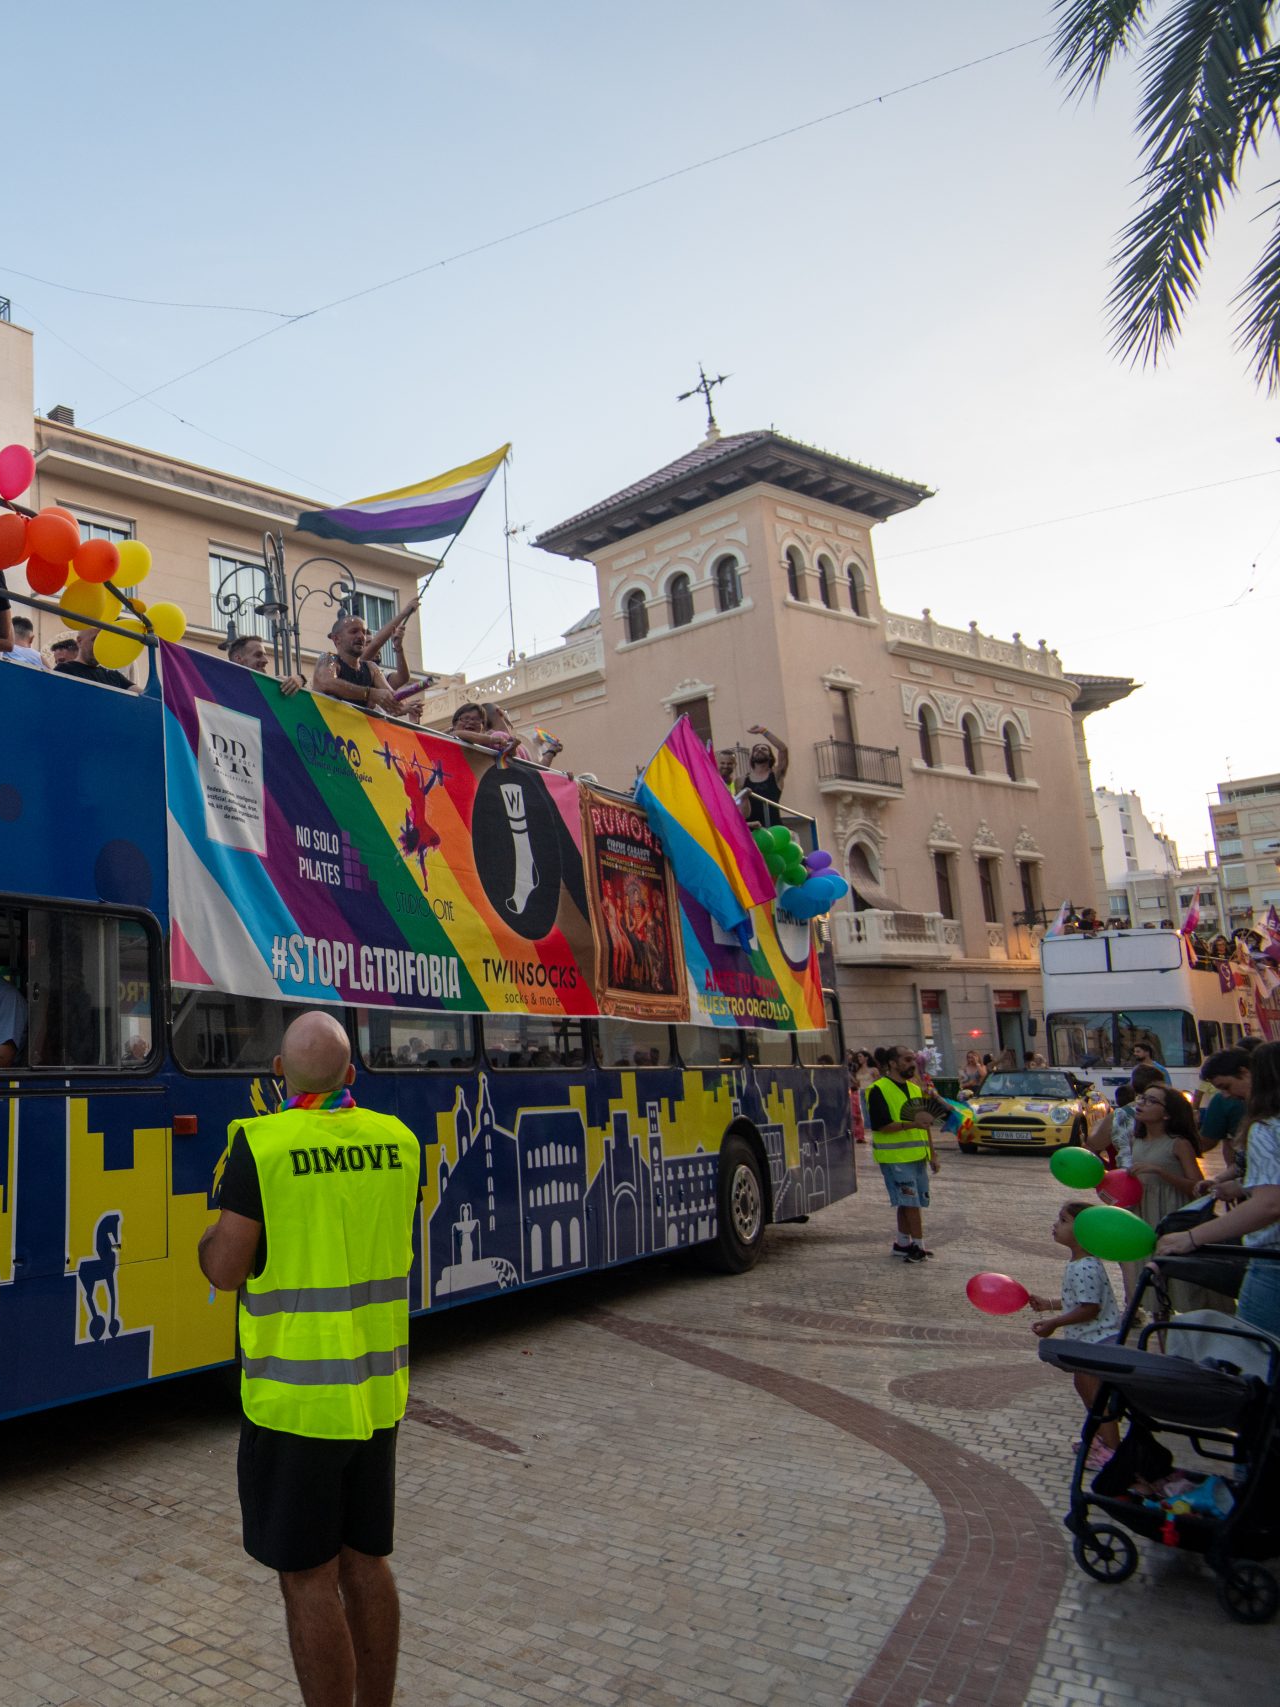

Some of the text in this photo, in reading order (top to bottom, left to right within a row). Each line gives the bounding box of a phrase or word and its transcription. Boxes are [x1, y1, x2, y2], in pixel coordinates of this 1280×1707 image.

[296, 824, 339, 856] NO SOLO
[298, 856, 341, 886] PILATES
[433, 898, 455, 922] ONE
[271, 932, 462, 999] #STOPLGTBIFOBIA
[482, 957, 578, 990] TWINSOCKS
[737, 972, 751, 994] TU
[504, 992, 561, 1008] socks & more
[696, 993, 746, 1017] NUESTRO
[746, 997, 791, 1021] ORGULLO
[288, 1143, 403, 1177] DIMOVE
